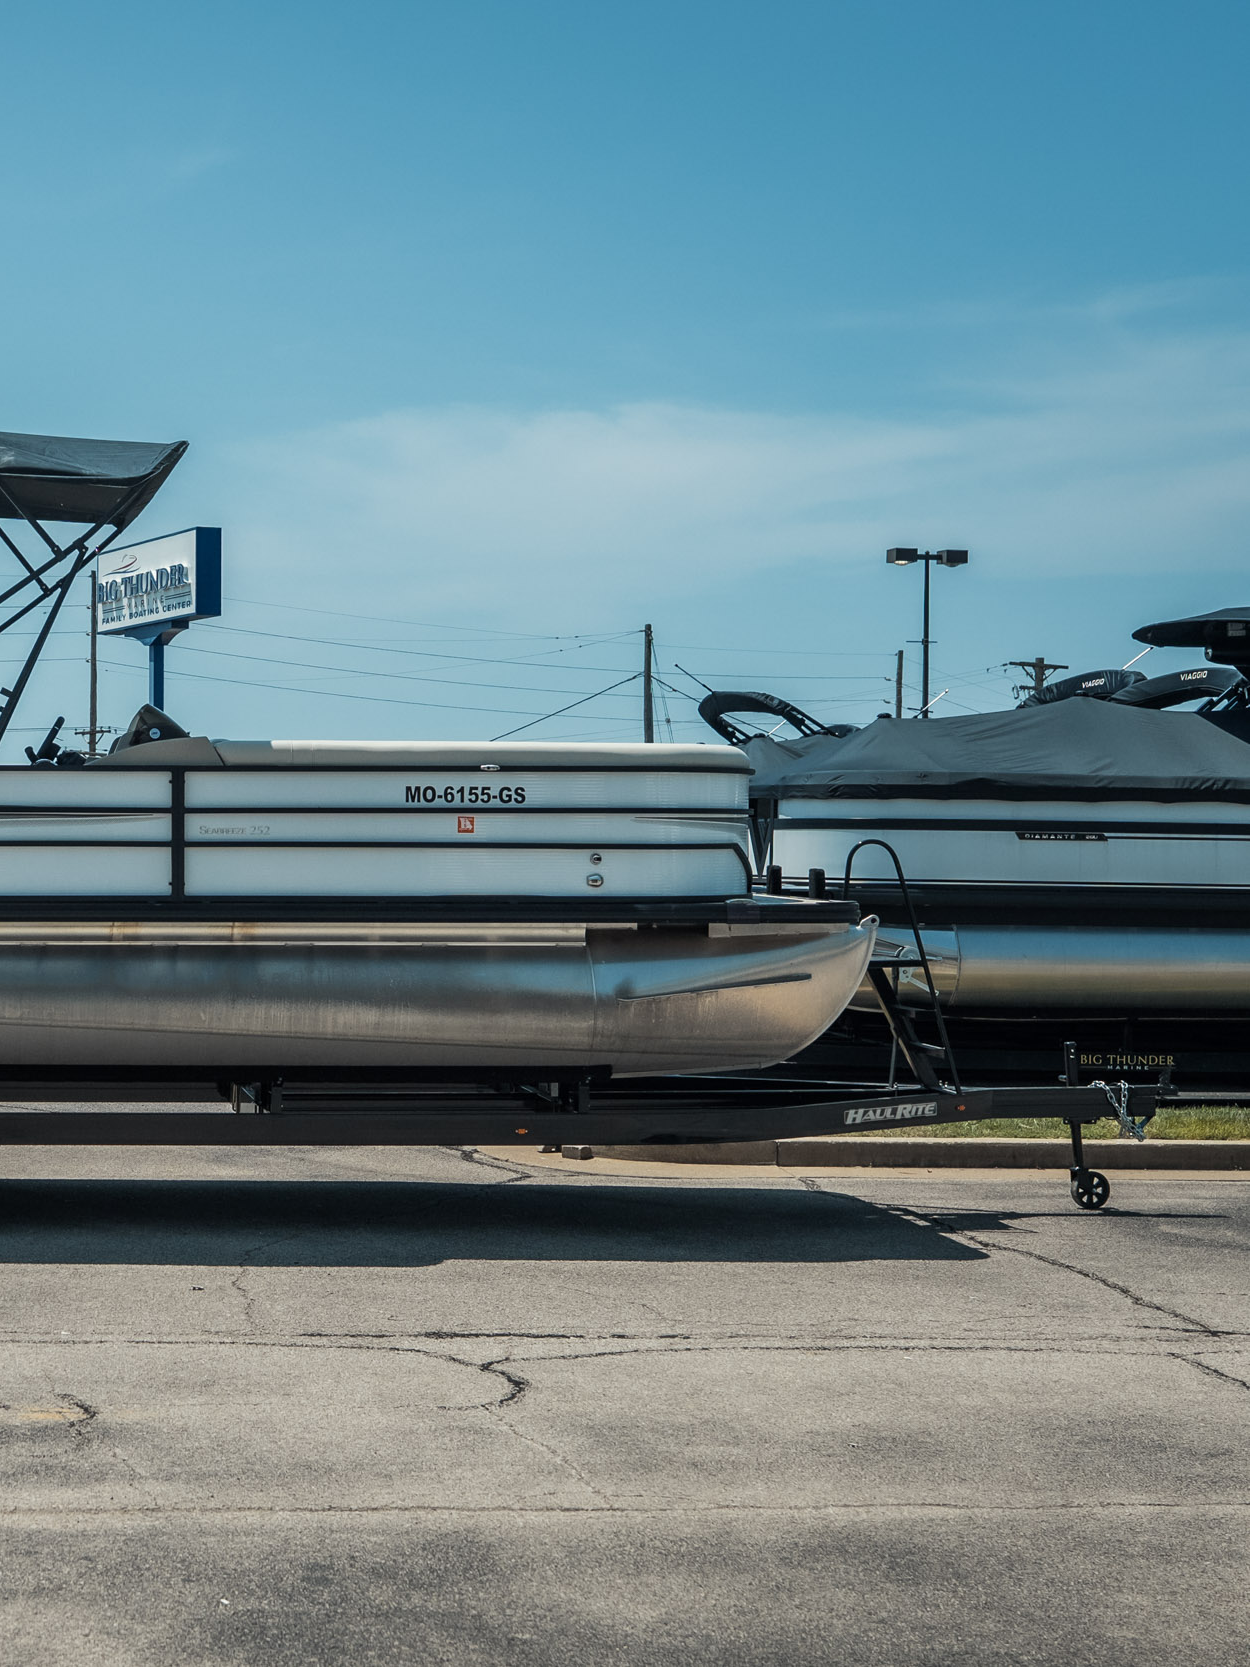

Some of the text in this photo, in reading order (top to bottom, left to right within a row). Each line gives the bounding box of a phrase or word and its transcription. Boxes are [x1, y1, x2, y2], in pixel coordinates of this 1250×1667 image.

[98, 563, 187, 604] BIG THUNDER
[102, 600, 191, 626] FAMILY BOATING CENTER
[1081, 678, 1106, 689] VIAGGIO
[1180, 670, 1209, 681] VIAGGIO
[405, 785, 526, 804] MO-6155-GS
[1080, 1054, 1175, 1066] BIG THUNDER
[846, 1102, 936, 1124] HAULRITE
